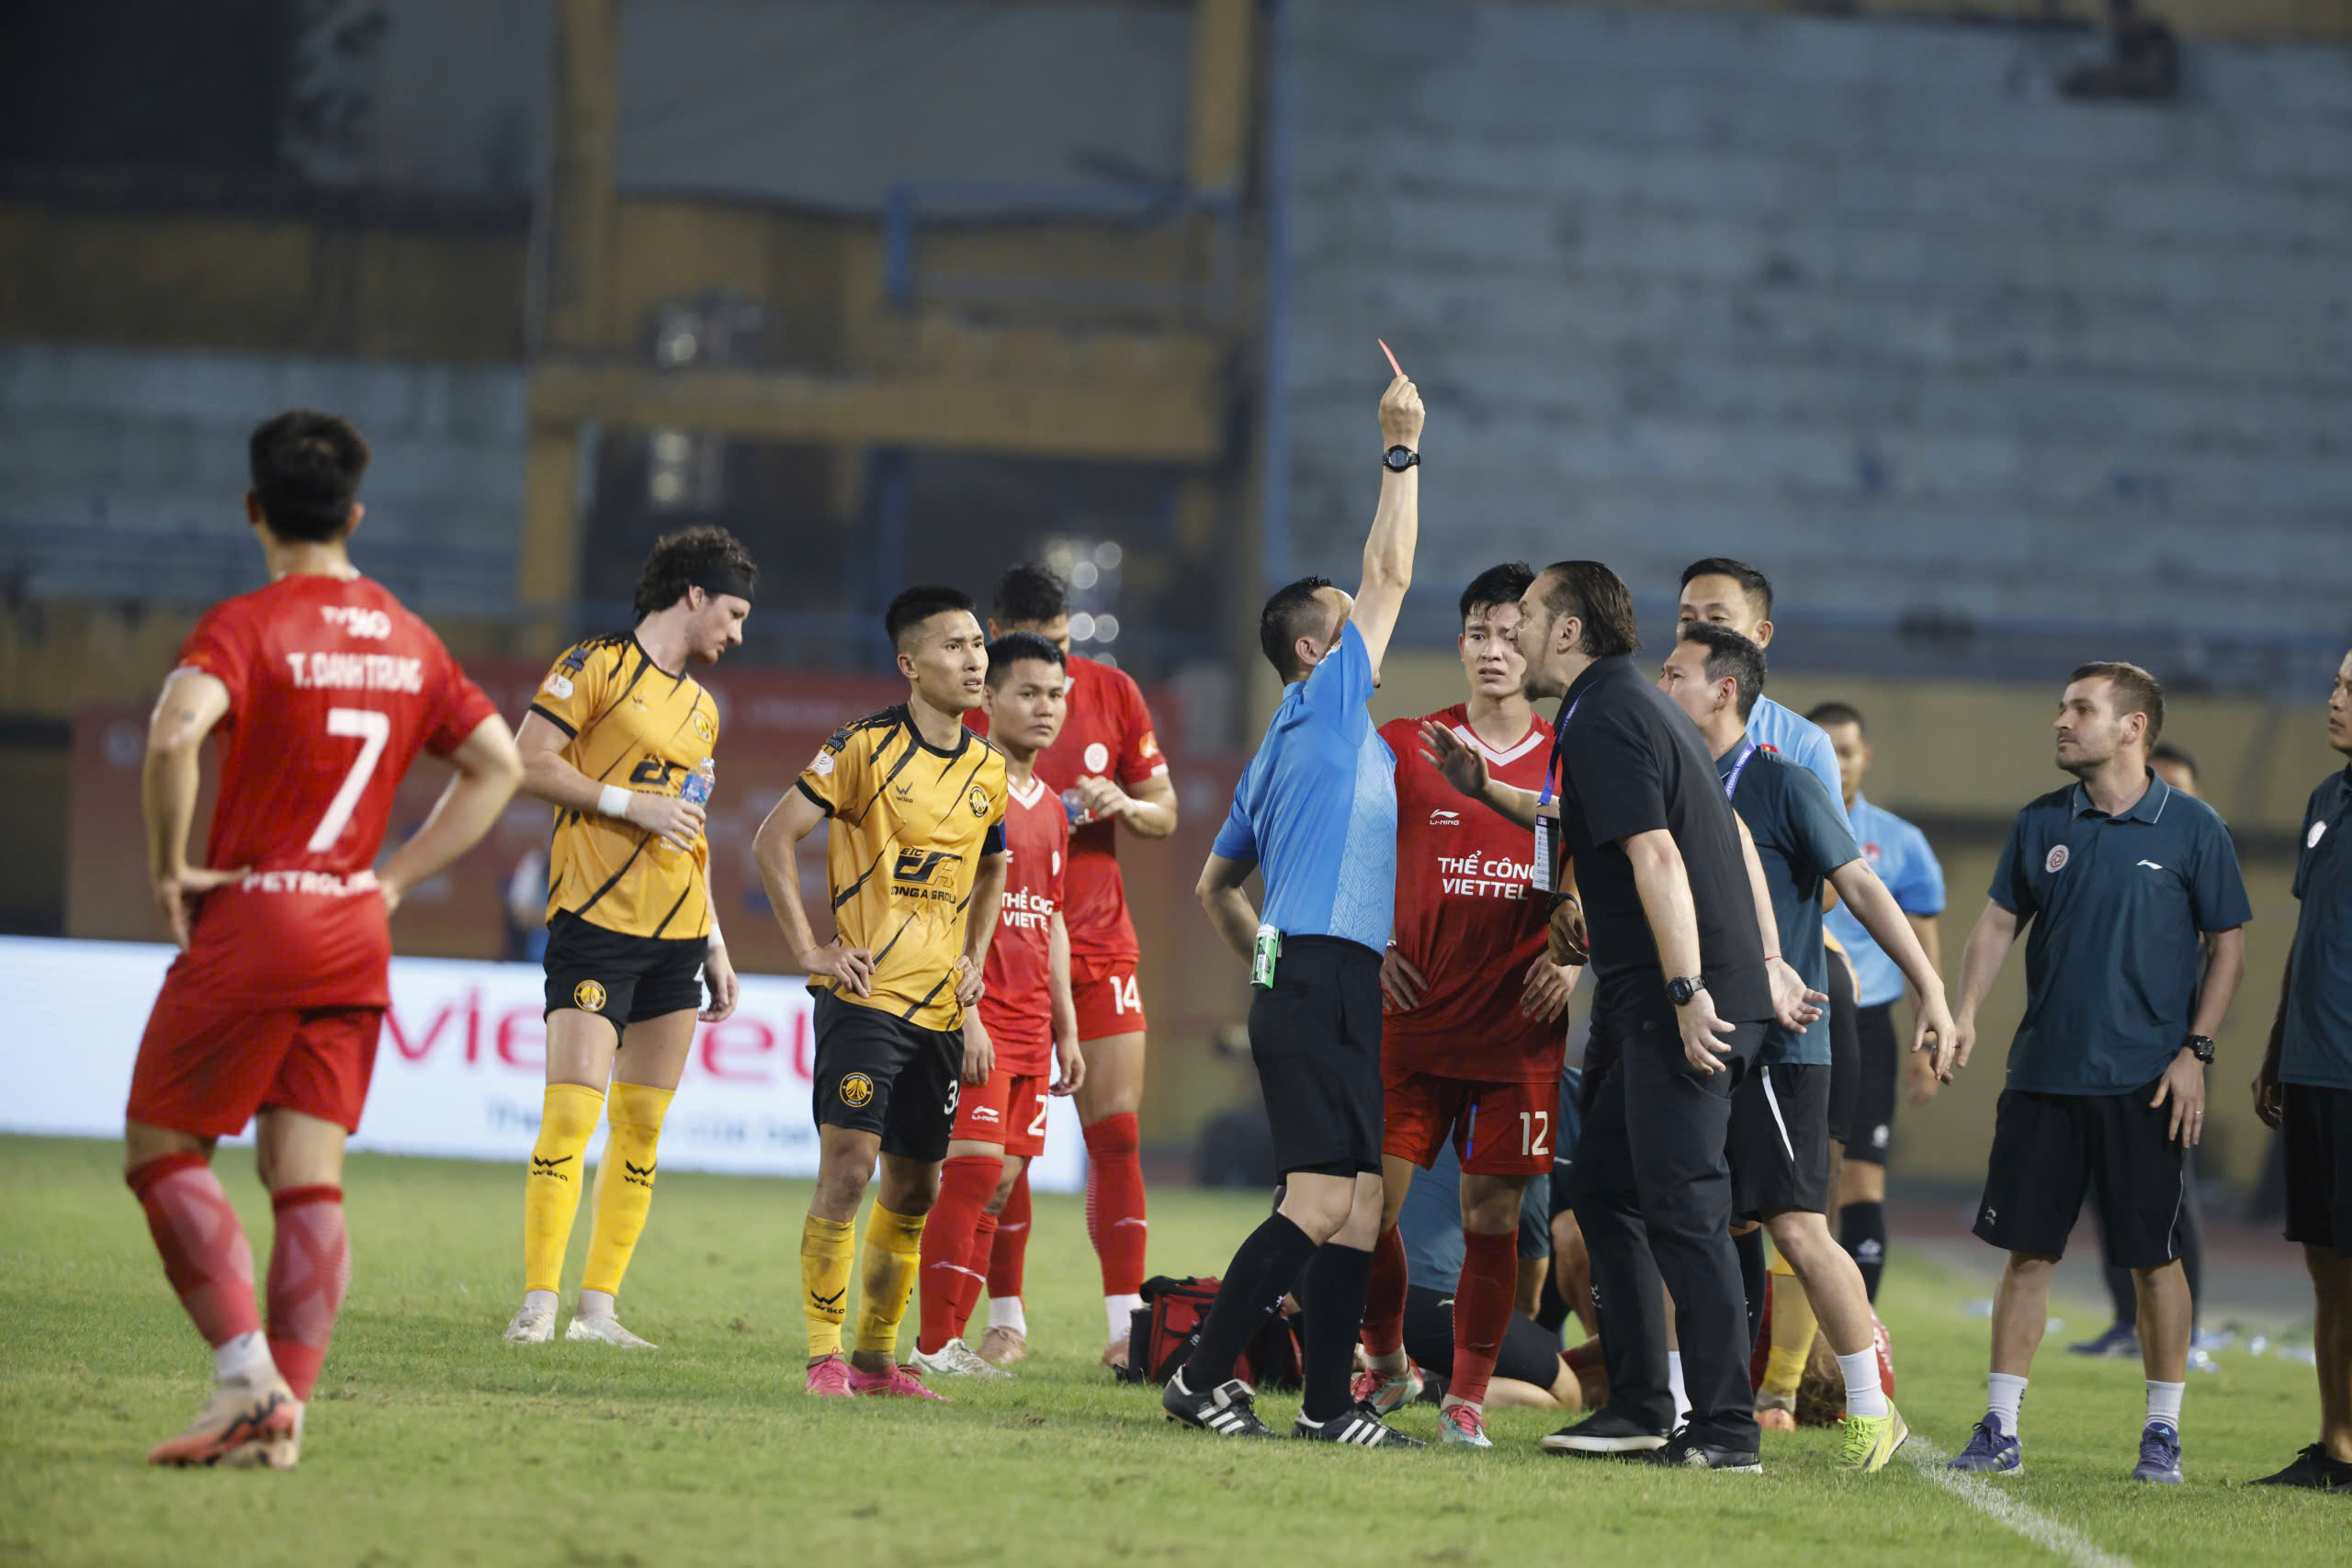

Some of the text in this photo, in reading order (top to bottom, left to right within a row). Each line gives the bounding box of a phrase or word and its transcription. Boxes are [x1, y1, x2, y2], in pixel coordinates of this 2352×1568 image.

[308, 707, 390, 852] 7
[899, 847, 924, 857] ETC
[1438, 851, 1482, 875] THỂ
[1442, 878, 1529, 899] VIETTEL
[1109, 975, 1142, 1015] 14
[1520, 1111, 1549, 1156] 12
